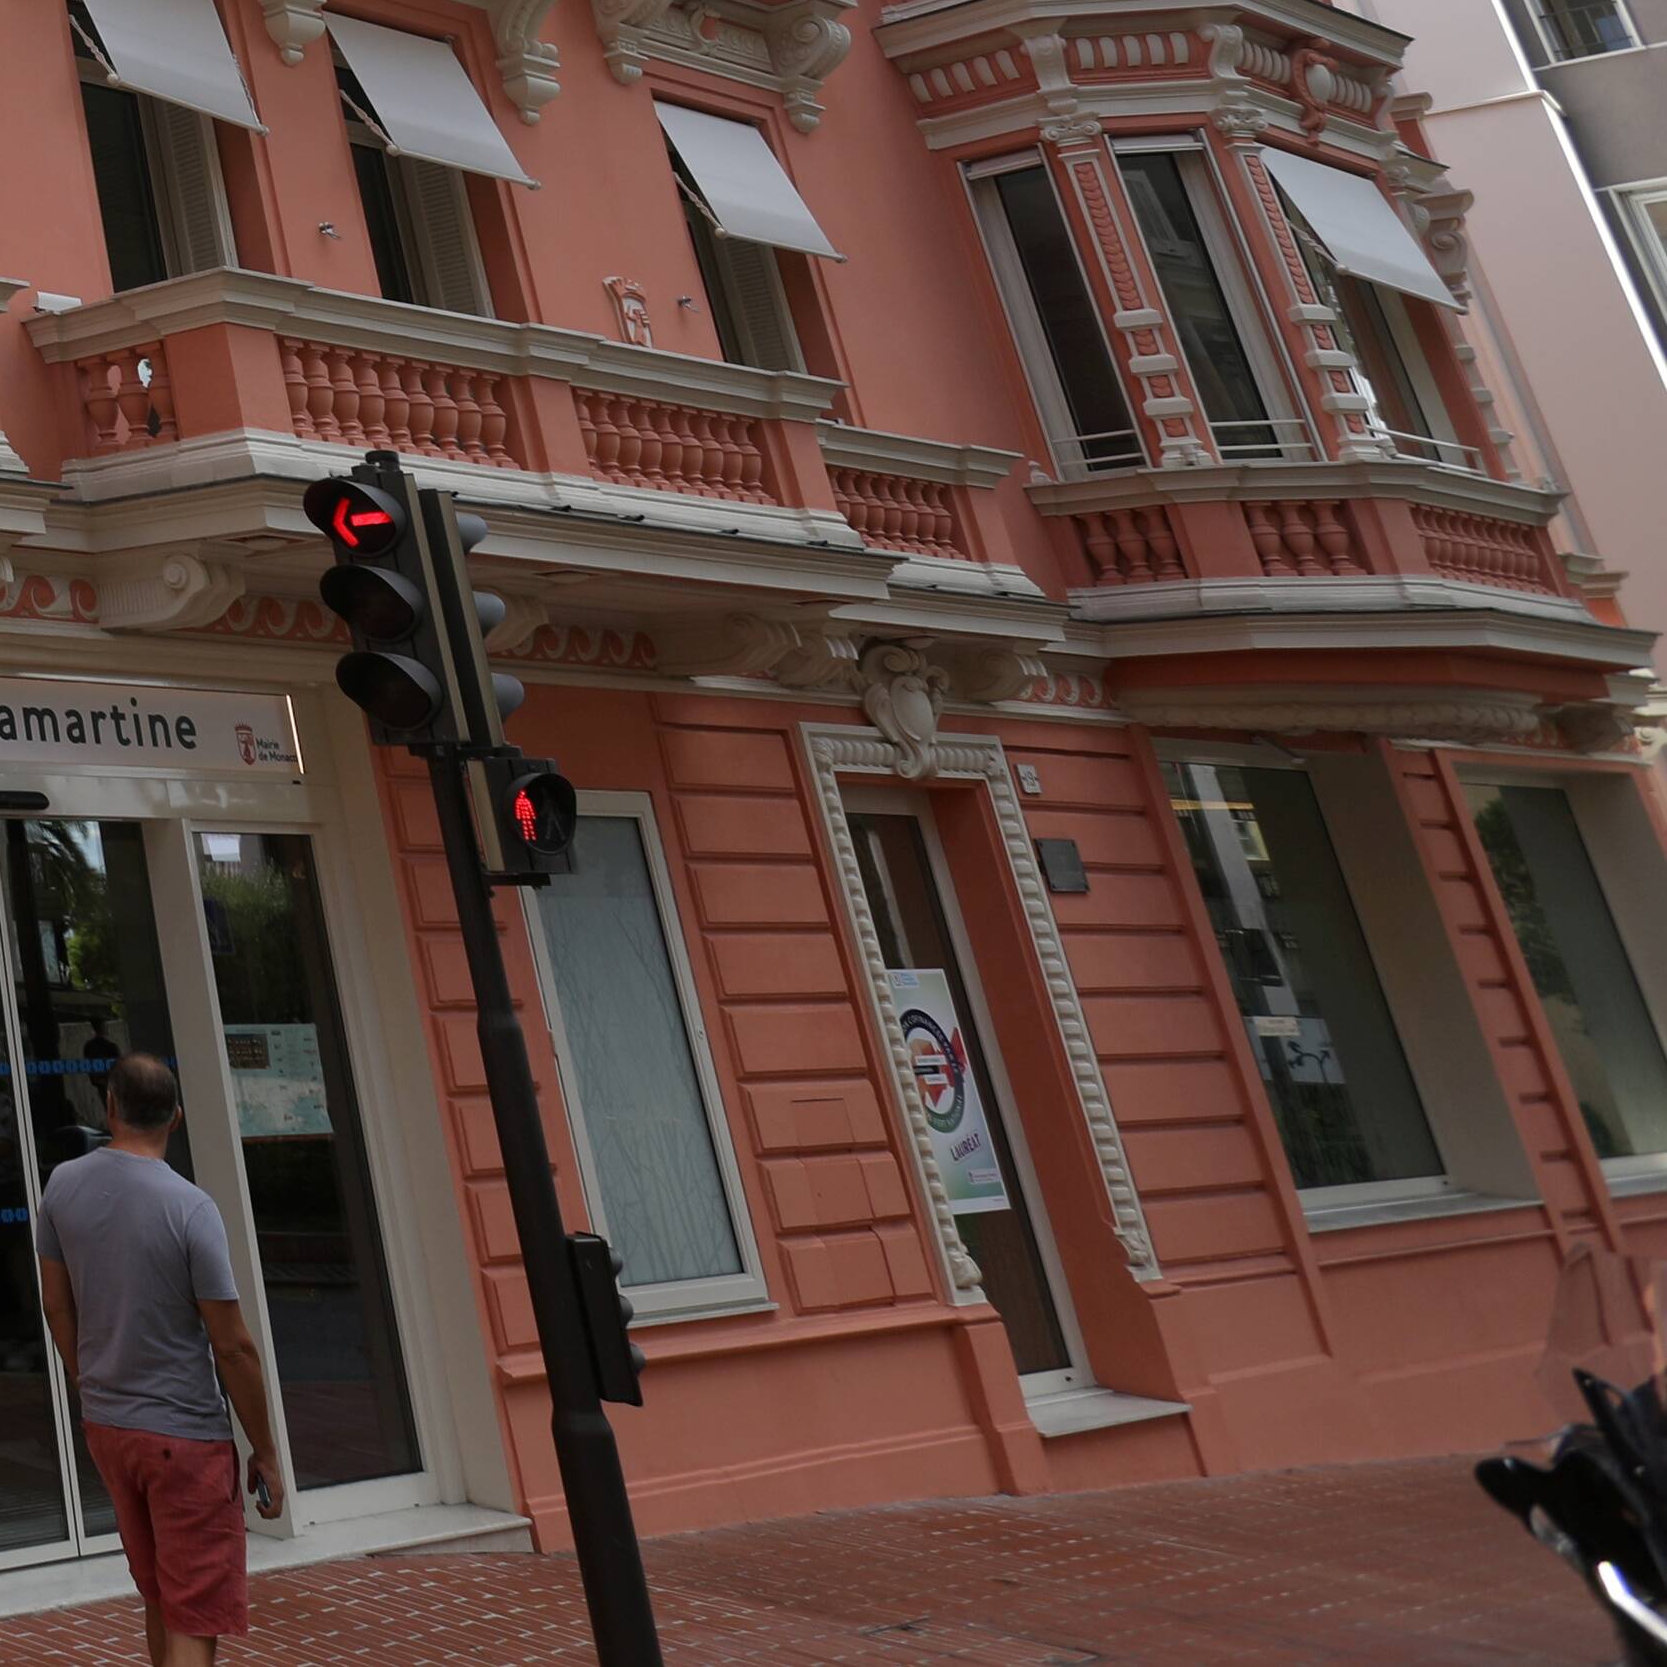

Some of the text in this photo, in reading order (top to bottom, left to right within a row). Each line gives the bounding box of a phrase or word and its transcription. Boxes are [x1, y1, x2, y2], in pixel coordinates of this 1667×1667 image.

[255, 737, 279, 750] Mairie
[258, 751, 268, 762] de
[949, 1132, 982, 1162] LAURÉAT
